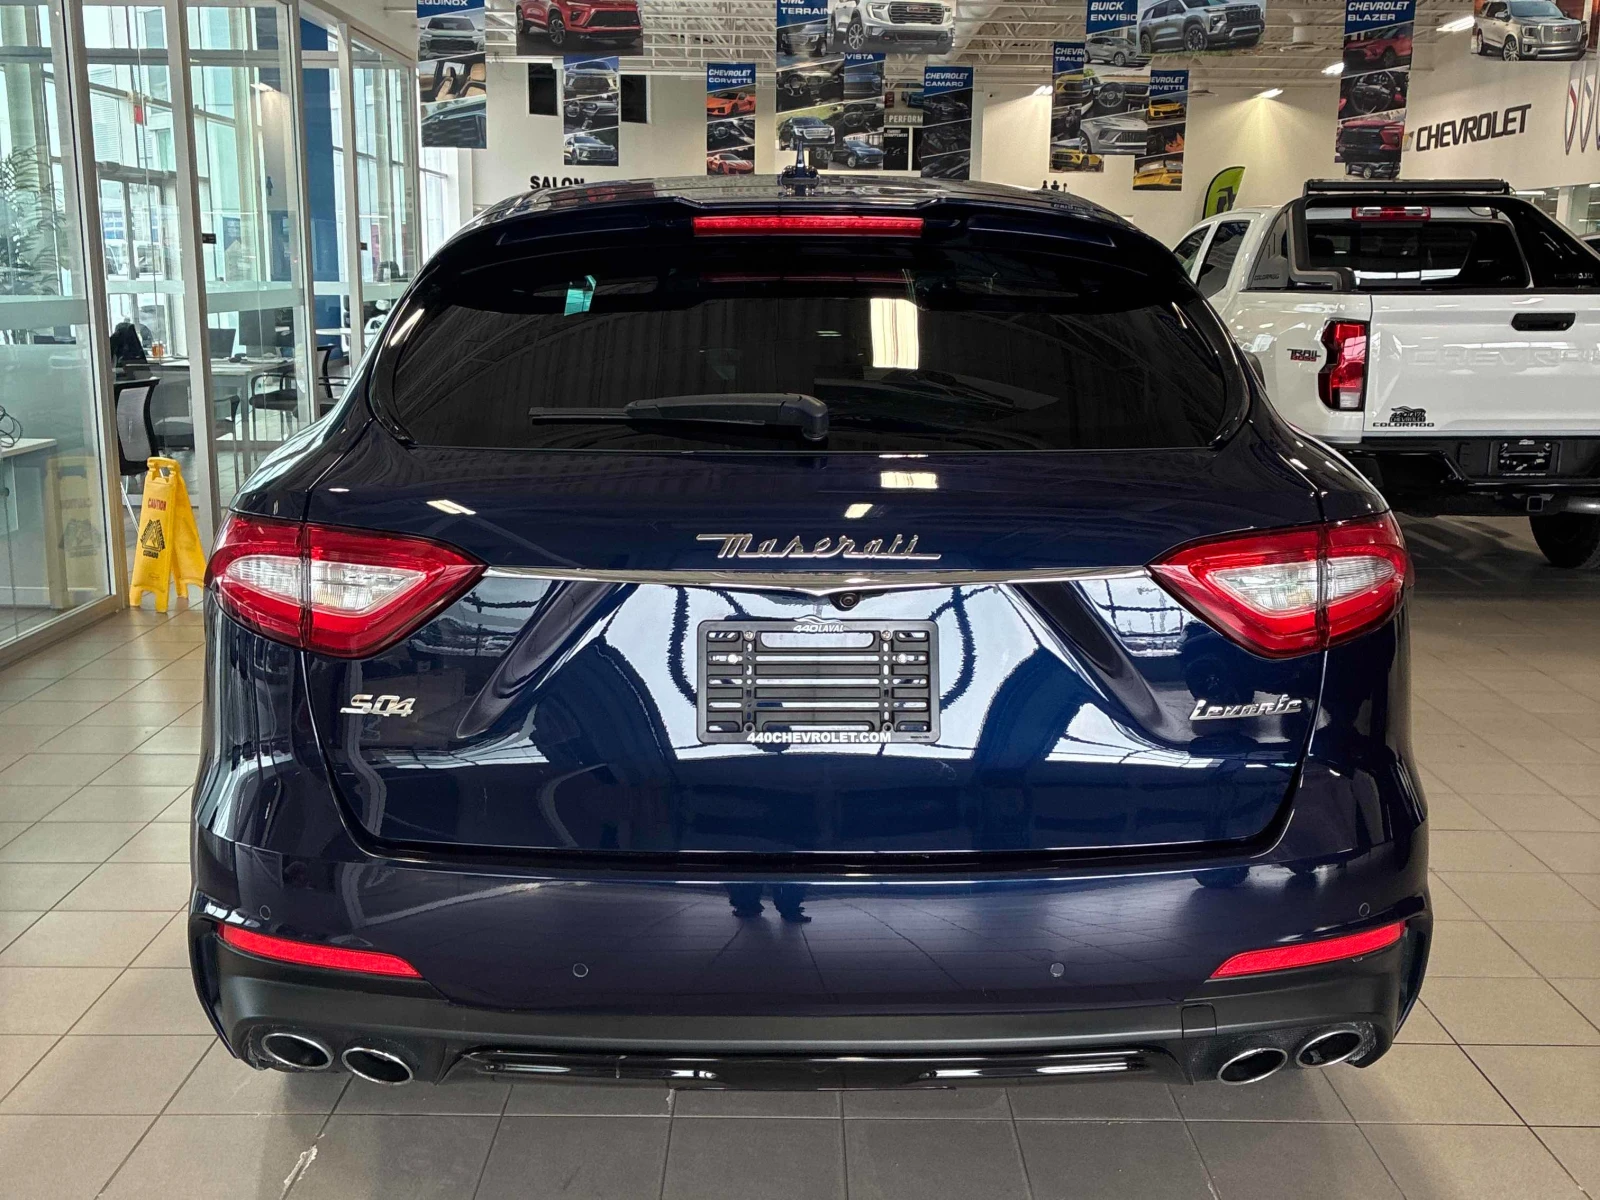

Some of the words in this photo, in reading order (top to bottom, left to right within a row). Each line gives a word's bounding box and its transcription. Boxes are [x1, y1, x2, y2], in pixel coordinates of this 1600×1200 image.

[1091, 2, 1124, 11] BUICK
[1348, 1, 1410, 11] CHEVROLET
[781, 7, 832, 15] TERRAIN
[1347, 13, 1396, 22] BLAZER
[1055, 47, 1085, 55] CHEVR
[708, 69, 752, 77] CHEVROLET
[925, 72, 969, 80] CHEVROLET
[1416, 103, 1532, 152] CHEVROLET
[696, 533, 942, 560] Maserati
[339, 693, 416, 717] SQ4
[1189, 693, 1303, 721] Levante
[746, 731, 892, 744] 440CHEVROLET.COM
